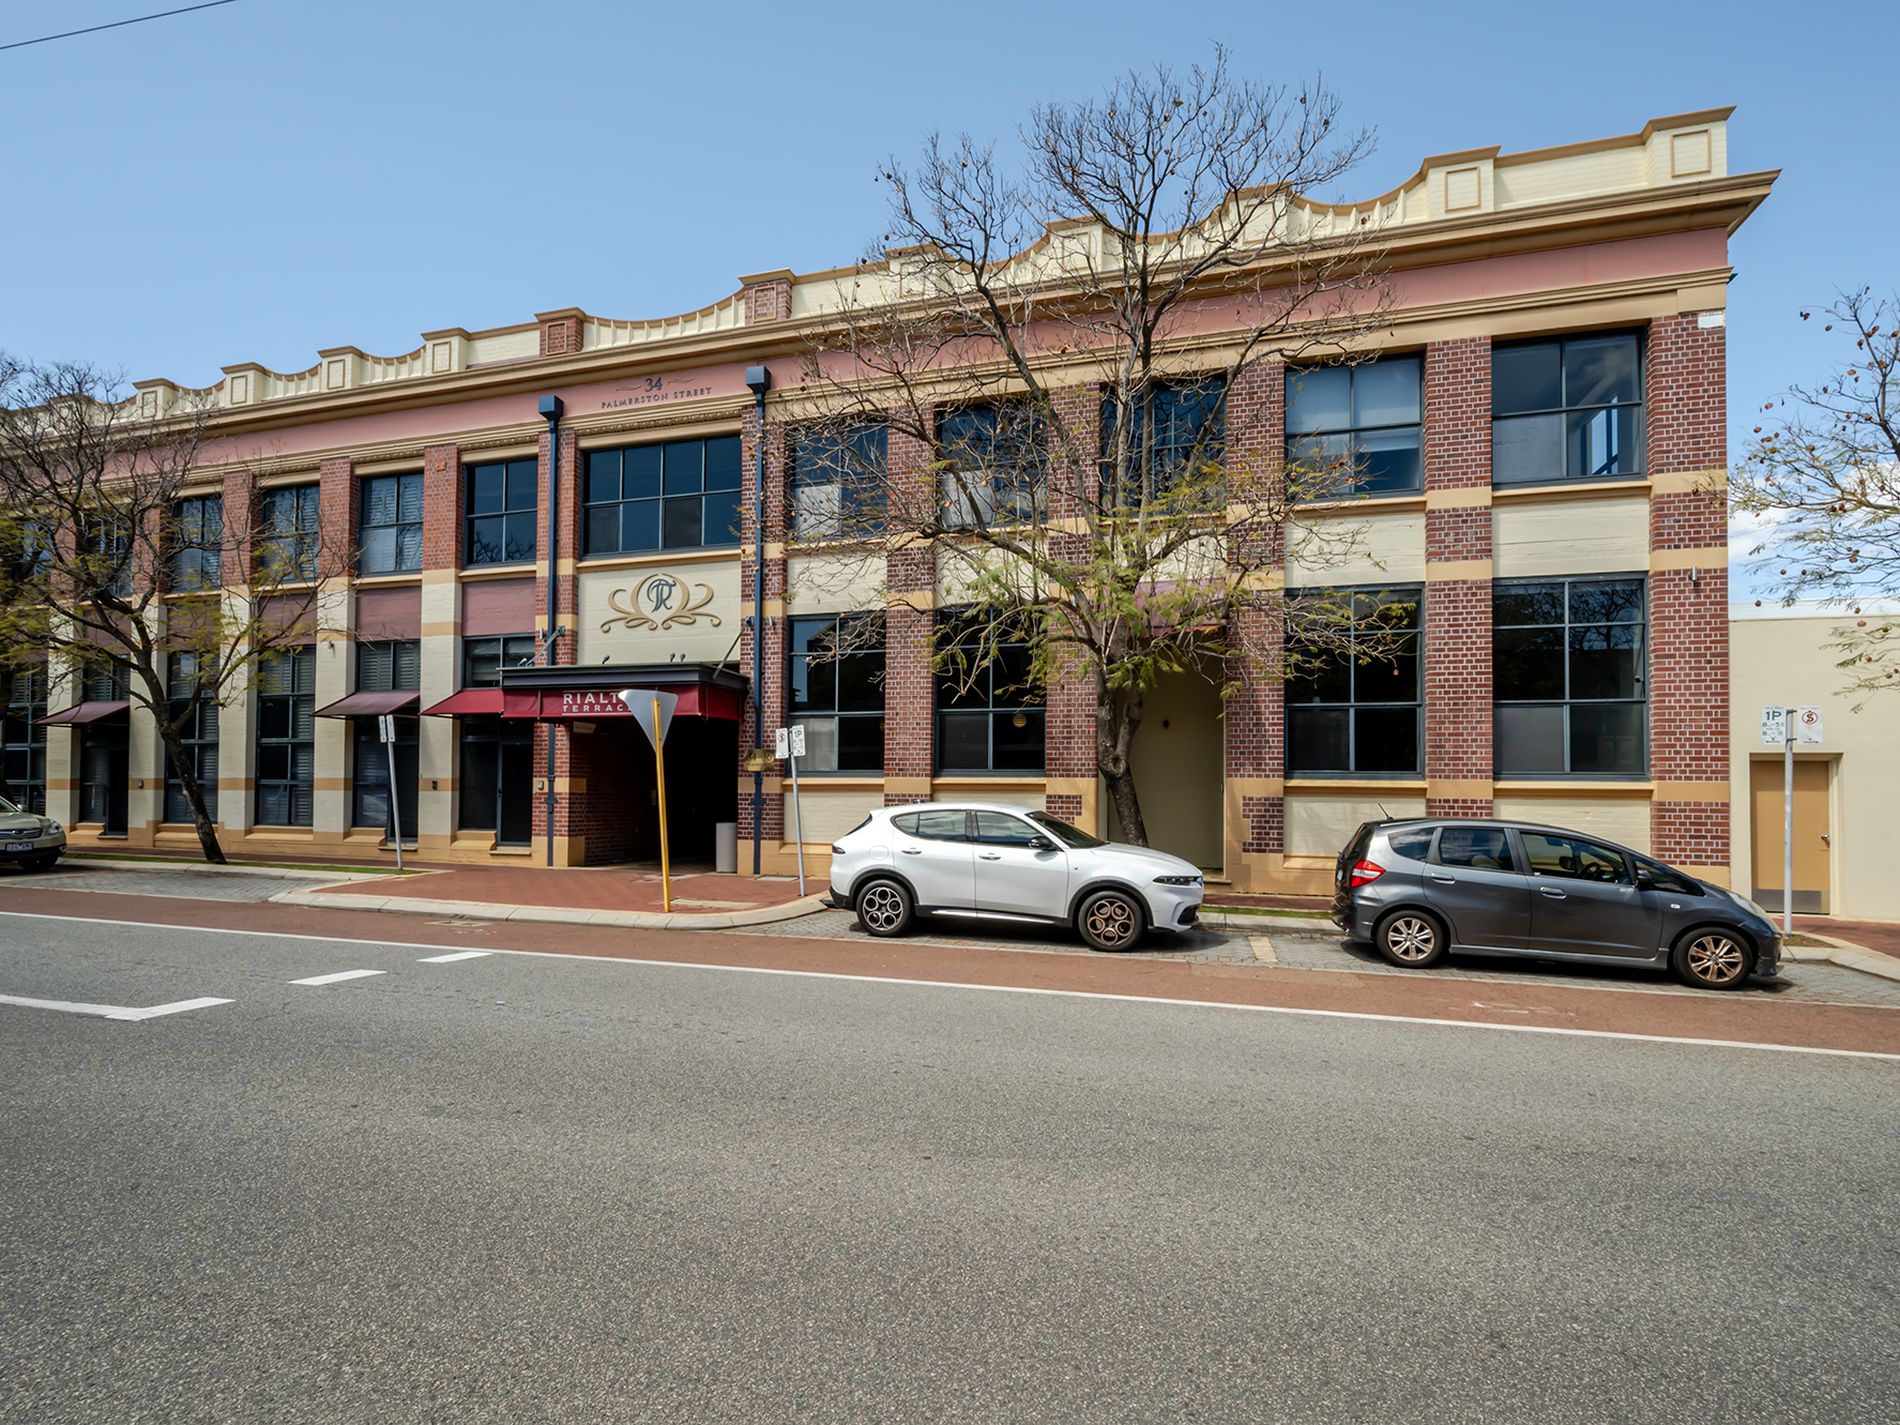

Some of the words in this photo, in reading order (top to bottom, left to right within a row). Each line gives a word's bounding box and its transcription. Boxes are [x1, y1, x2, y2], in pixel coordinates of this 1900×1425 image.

[644, 377, 663, 392] 34
[601, 393, 668, 409] PALMERSTON
[673, 387, 712, 399] STREET
[563, 693, 618, 704] RIALT
[1766, 711, 1782, 720] 1P
